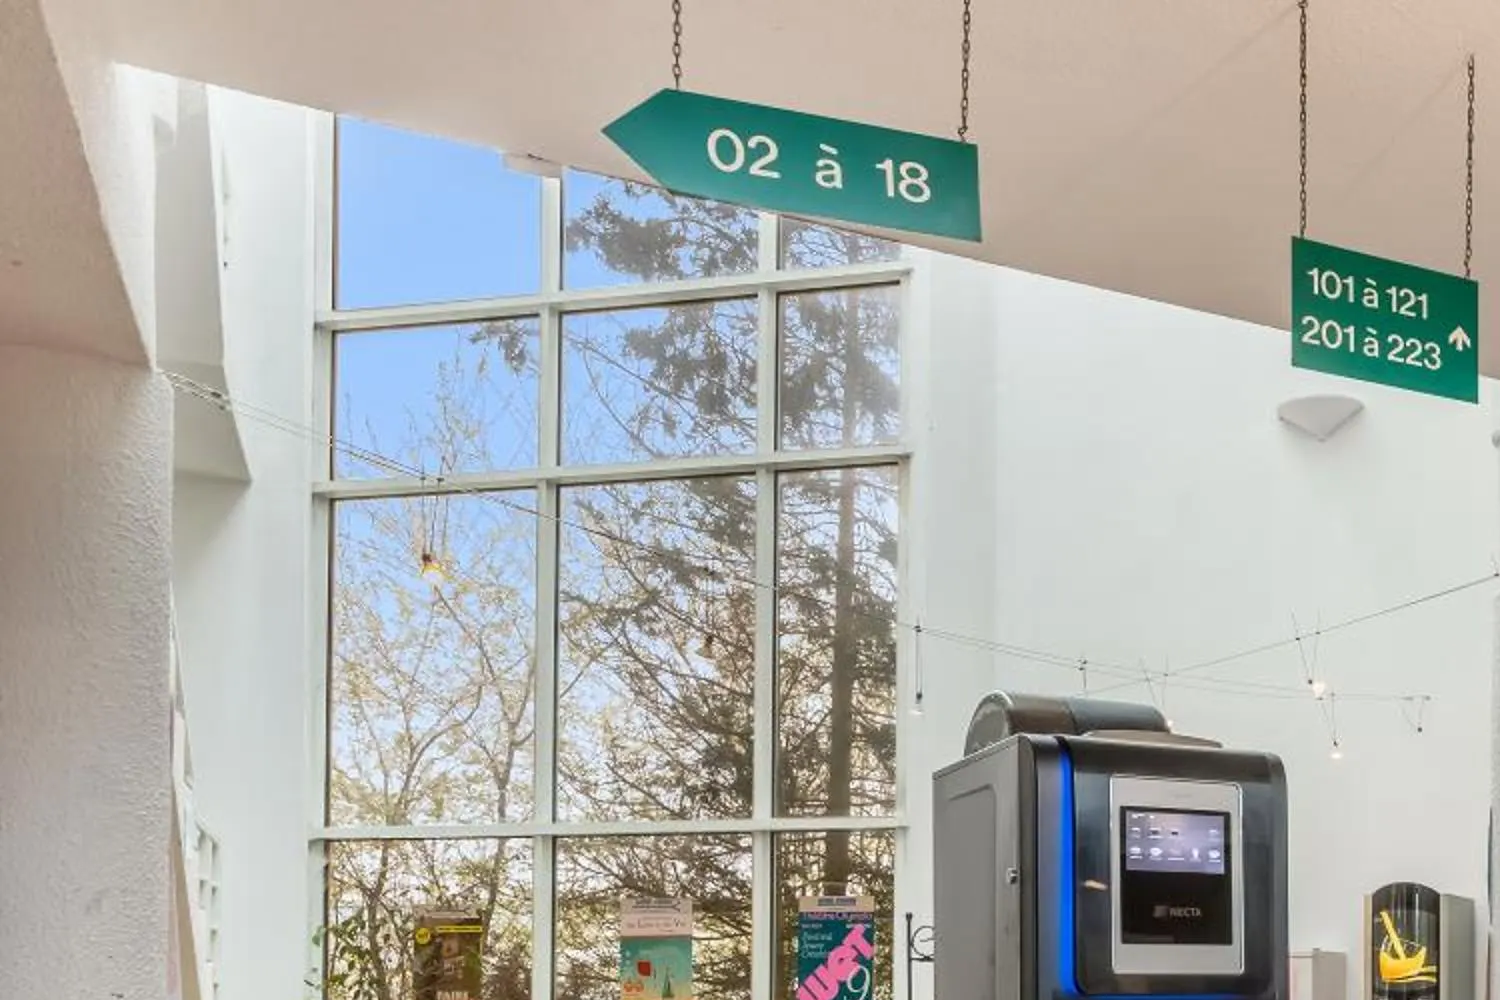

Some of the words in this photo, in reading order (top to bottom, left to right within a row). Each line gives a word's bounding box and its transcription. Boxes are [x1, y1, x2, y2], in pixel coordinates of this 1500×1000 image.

[706, 128, 781, 179] 02
[815, 143, 844, 190] à
[875, 158, 932, 204] 18
[1306, 267, 1355, 304] 101
[1361, 277, 1379, 309] à
[1386, 286, 1429, 320] 121
[1301, 315, 1355, 353] 201
[1362, 327, 1380, 358] à
[1387, 334, 1442, 370] 223
